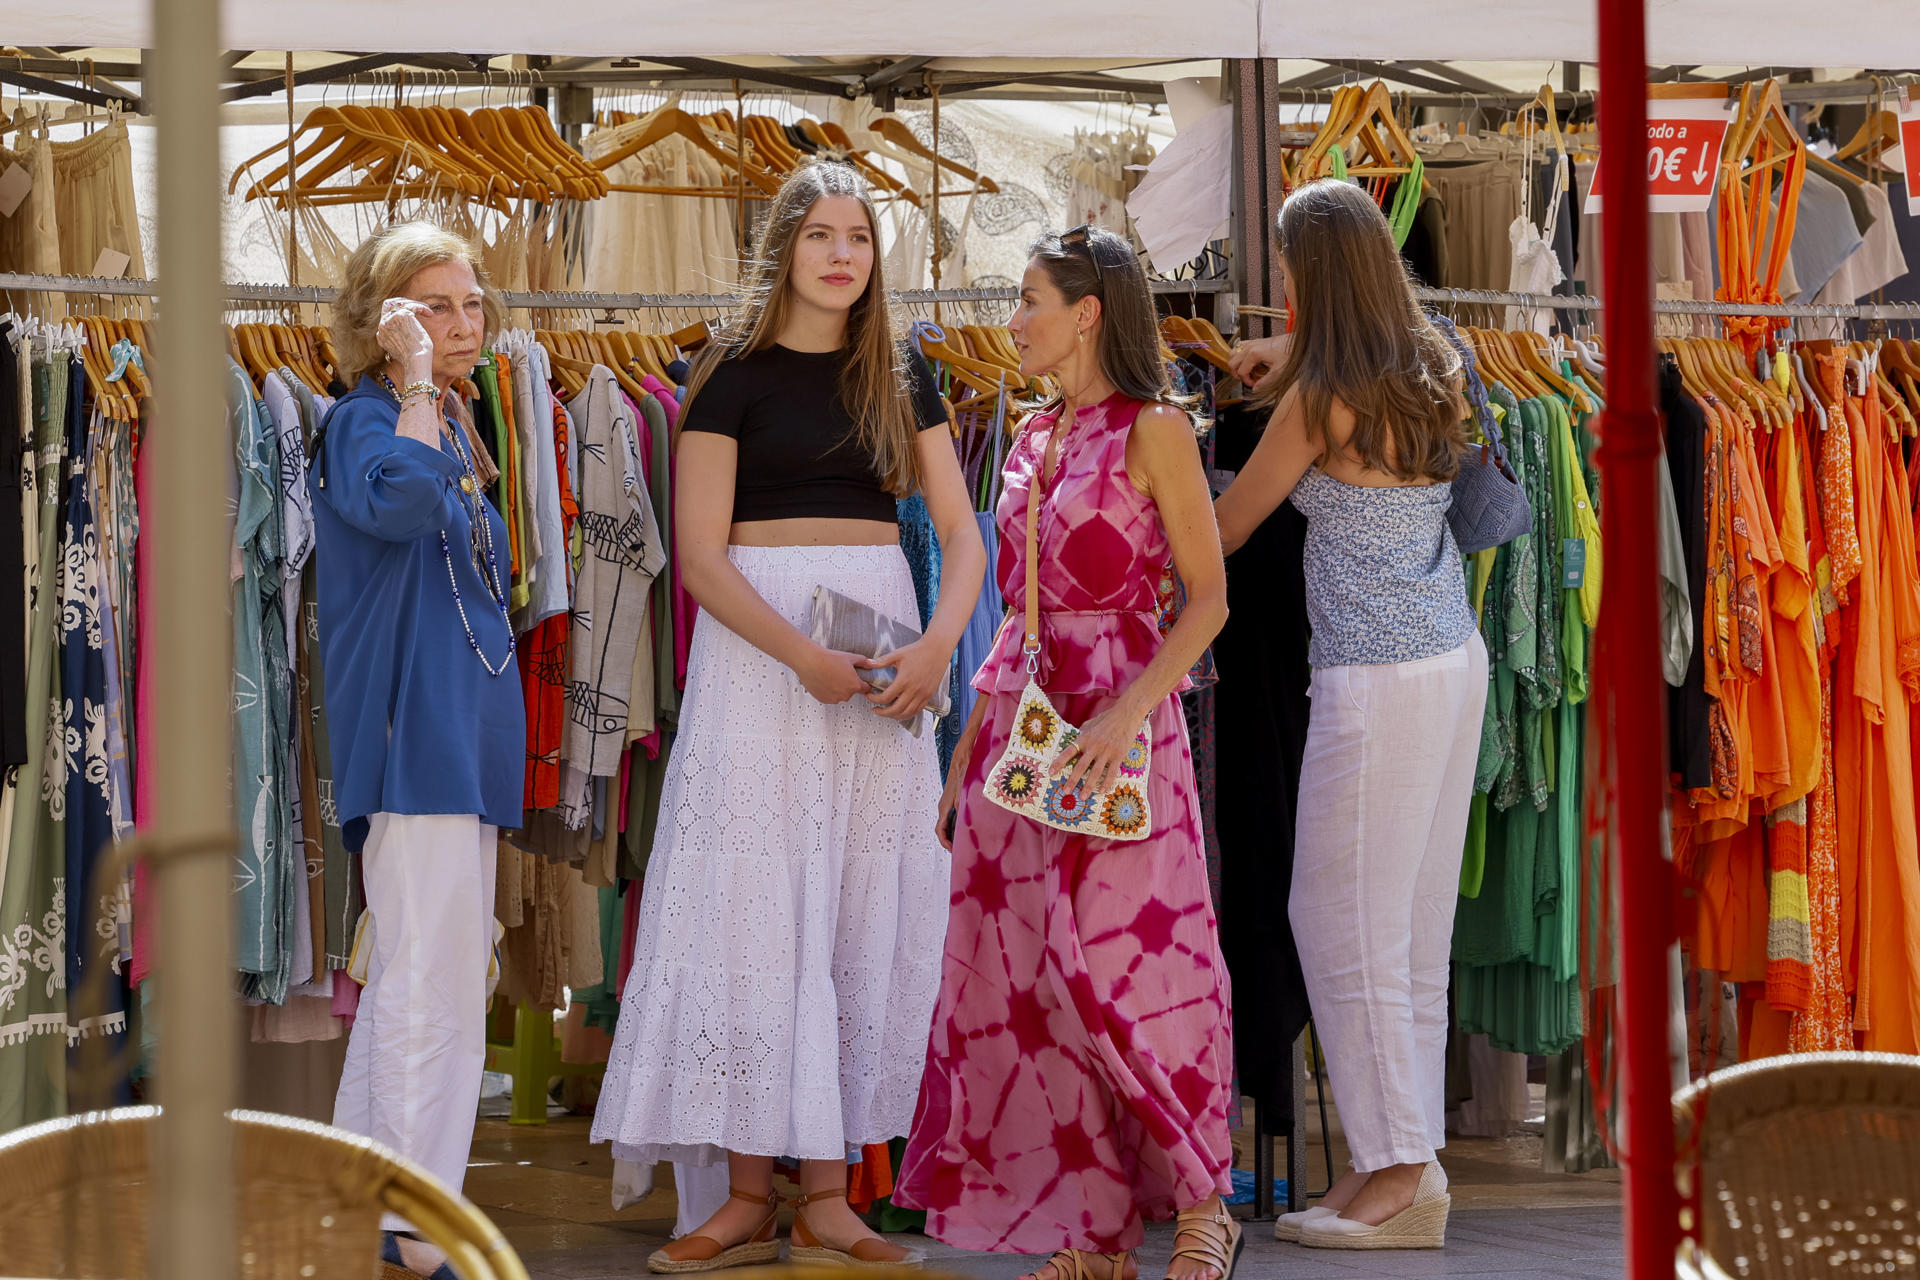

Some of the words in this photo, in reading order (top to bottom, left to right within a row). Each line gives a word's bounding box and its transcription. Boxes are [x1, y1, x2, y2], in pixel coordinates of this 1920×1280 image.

[1646, 123, 1674, 138] odo
[1677, 127, 1687, 138] a
[1647, 146, 1688, 181] 0€
